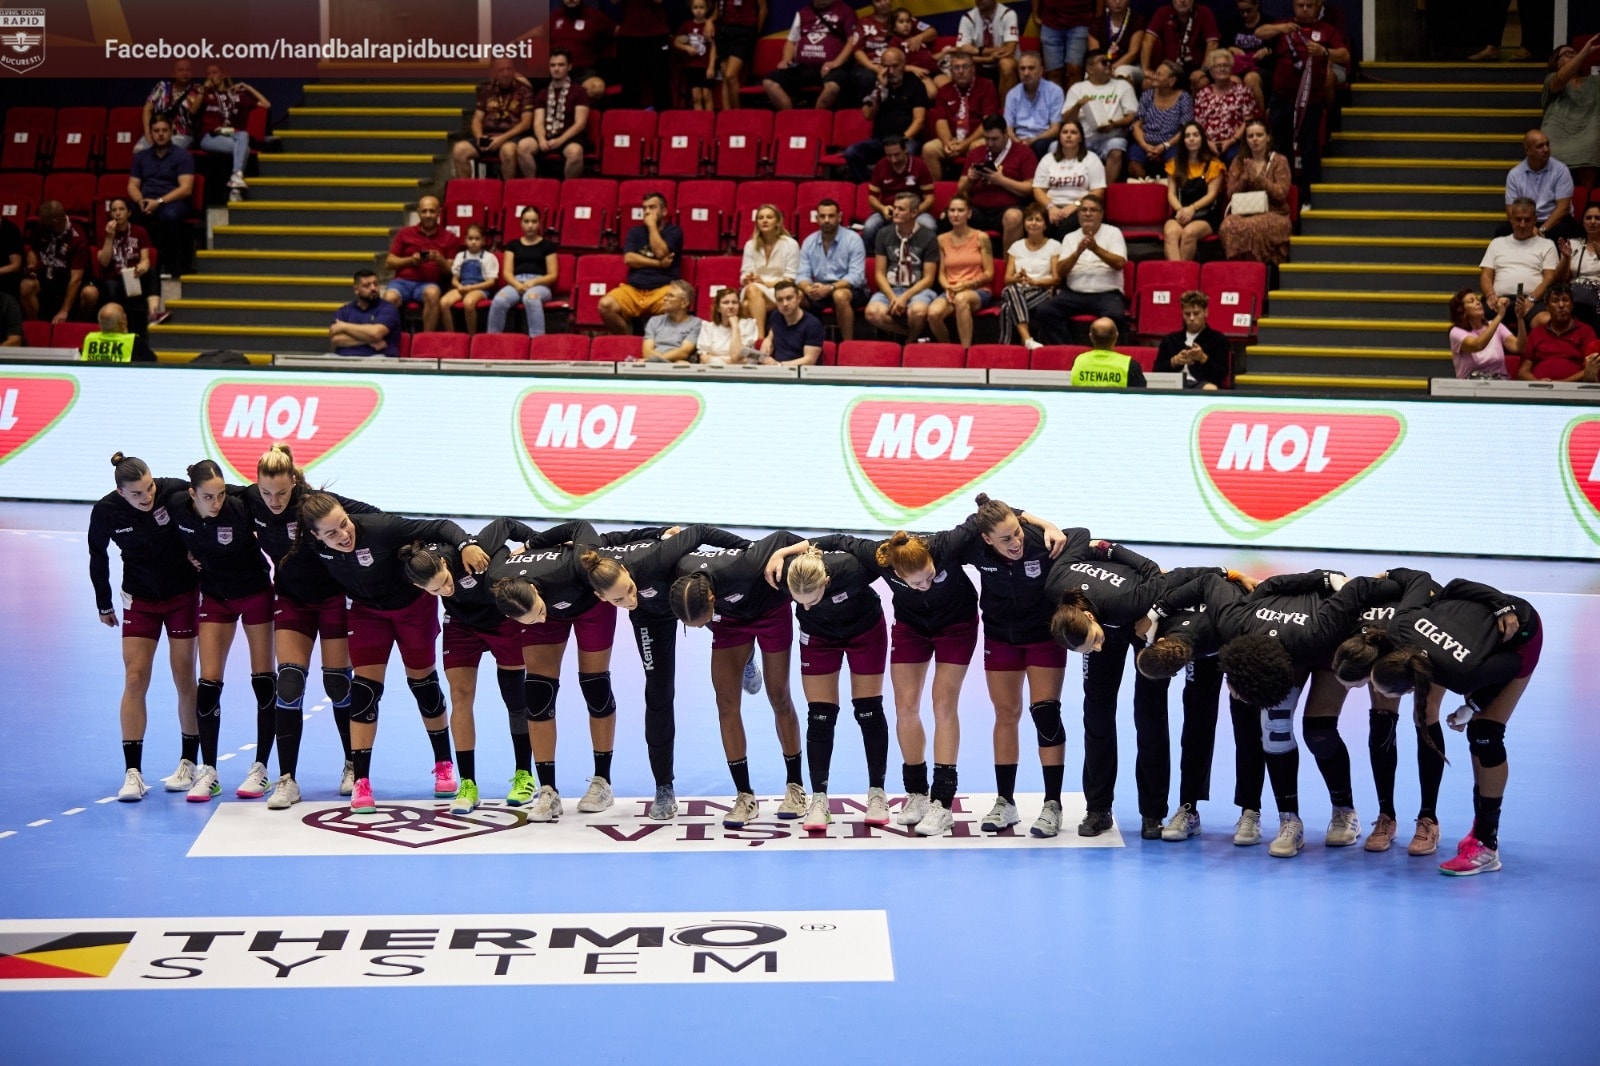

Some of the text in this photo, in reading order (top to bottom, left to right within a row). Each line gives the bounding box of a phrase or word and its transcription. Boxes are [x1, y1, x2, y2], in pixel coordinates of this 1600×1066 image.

[1048, 175, 1086, 187] RAPID
[88, 341, 124, 355] BBK
[1079, 371, 1121, 383] STEWARD
[222, 395, 320, 439] MOL
[535, 403, 637, 450] MOL
[866, 413, 975, 461] MOL
[1216, 423, 1331, 472] MOL
[1070, 562, 1127, 588] RAPID
[640, 627, 655, 670] Kempa
[1414, 618, 1470, 663] RAPID
[163, 922, 787, 952] THERMO
[141, 951, 777, 980] SYSTEM
